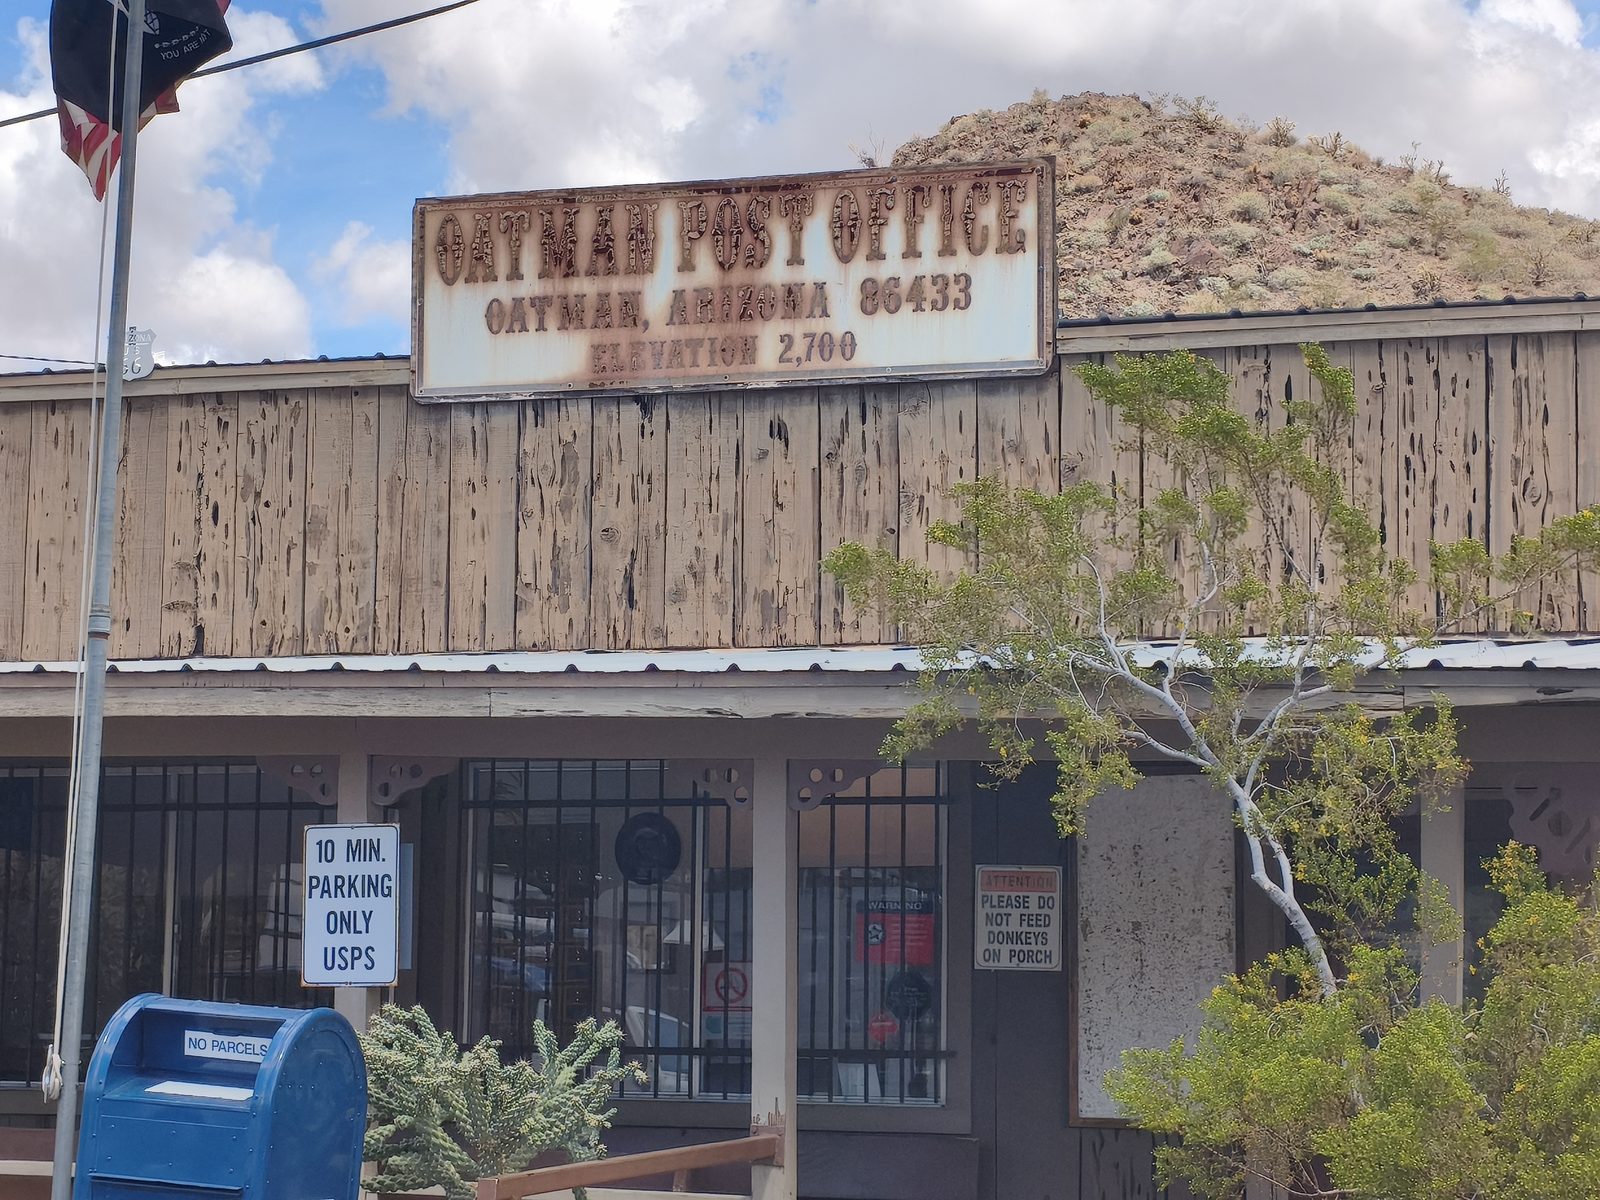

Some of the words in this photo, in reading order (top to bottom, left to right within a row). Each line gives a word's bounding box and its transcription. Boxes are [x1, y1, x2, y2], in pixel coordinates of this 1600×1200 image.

[160, 49, 180, 60] YOU
[183, 41, 200, 54] ARE
[436, 203, 657, 286] OATMAN
[678, 193, 814, 272] POST
[831, 178, 1027, 264] OFFICE
[485, 291, 649, 334] OATMAN,
[666, 282, 830, 326] ARIZONA
[860, 272, 972, 316] 86433
[590, 335, 758, 373] ELEVATION
[778, 331, 857, 367] 2,700
[316, 839, 335, 863] 10
[346, 838, 386, 863] MIN.
[308, 873, 392, 899] PARKING
[986, 874, 1053, 888] ATTENTION
[868, 901, 922, 910] WARNNG
[981, 895, 1030, 909] PLEASE
[1038, 896, 1055, 910] DO
[326, 910, 374, 935] ONLY
[985, 912, 1012, 926] NOT
[1020, 913, 1051, 927] FEED
[988, 931, 1048, 945] DONKEYS
[323, 946, 375, 971] USPS
[983, 948, 1000, 963] ON
[1009, 949, 1052, 964] PORCH
[188, 1037, 207, 1051] NO
[212, 1040, 268, 1057] PARCELS
